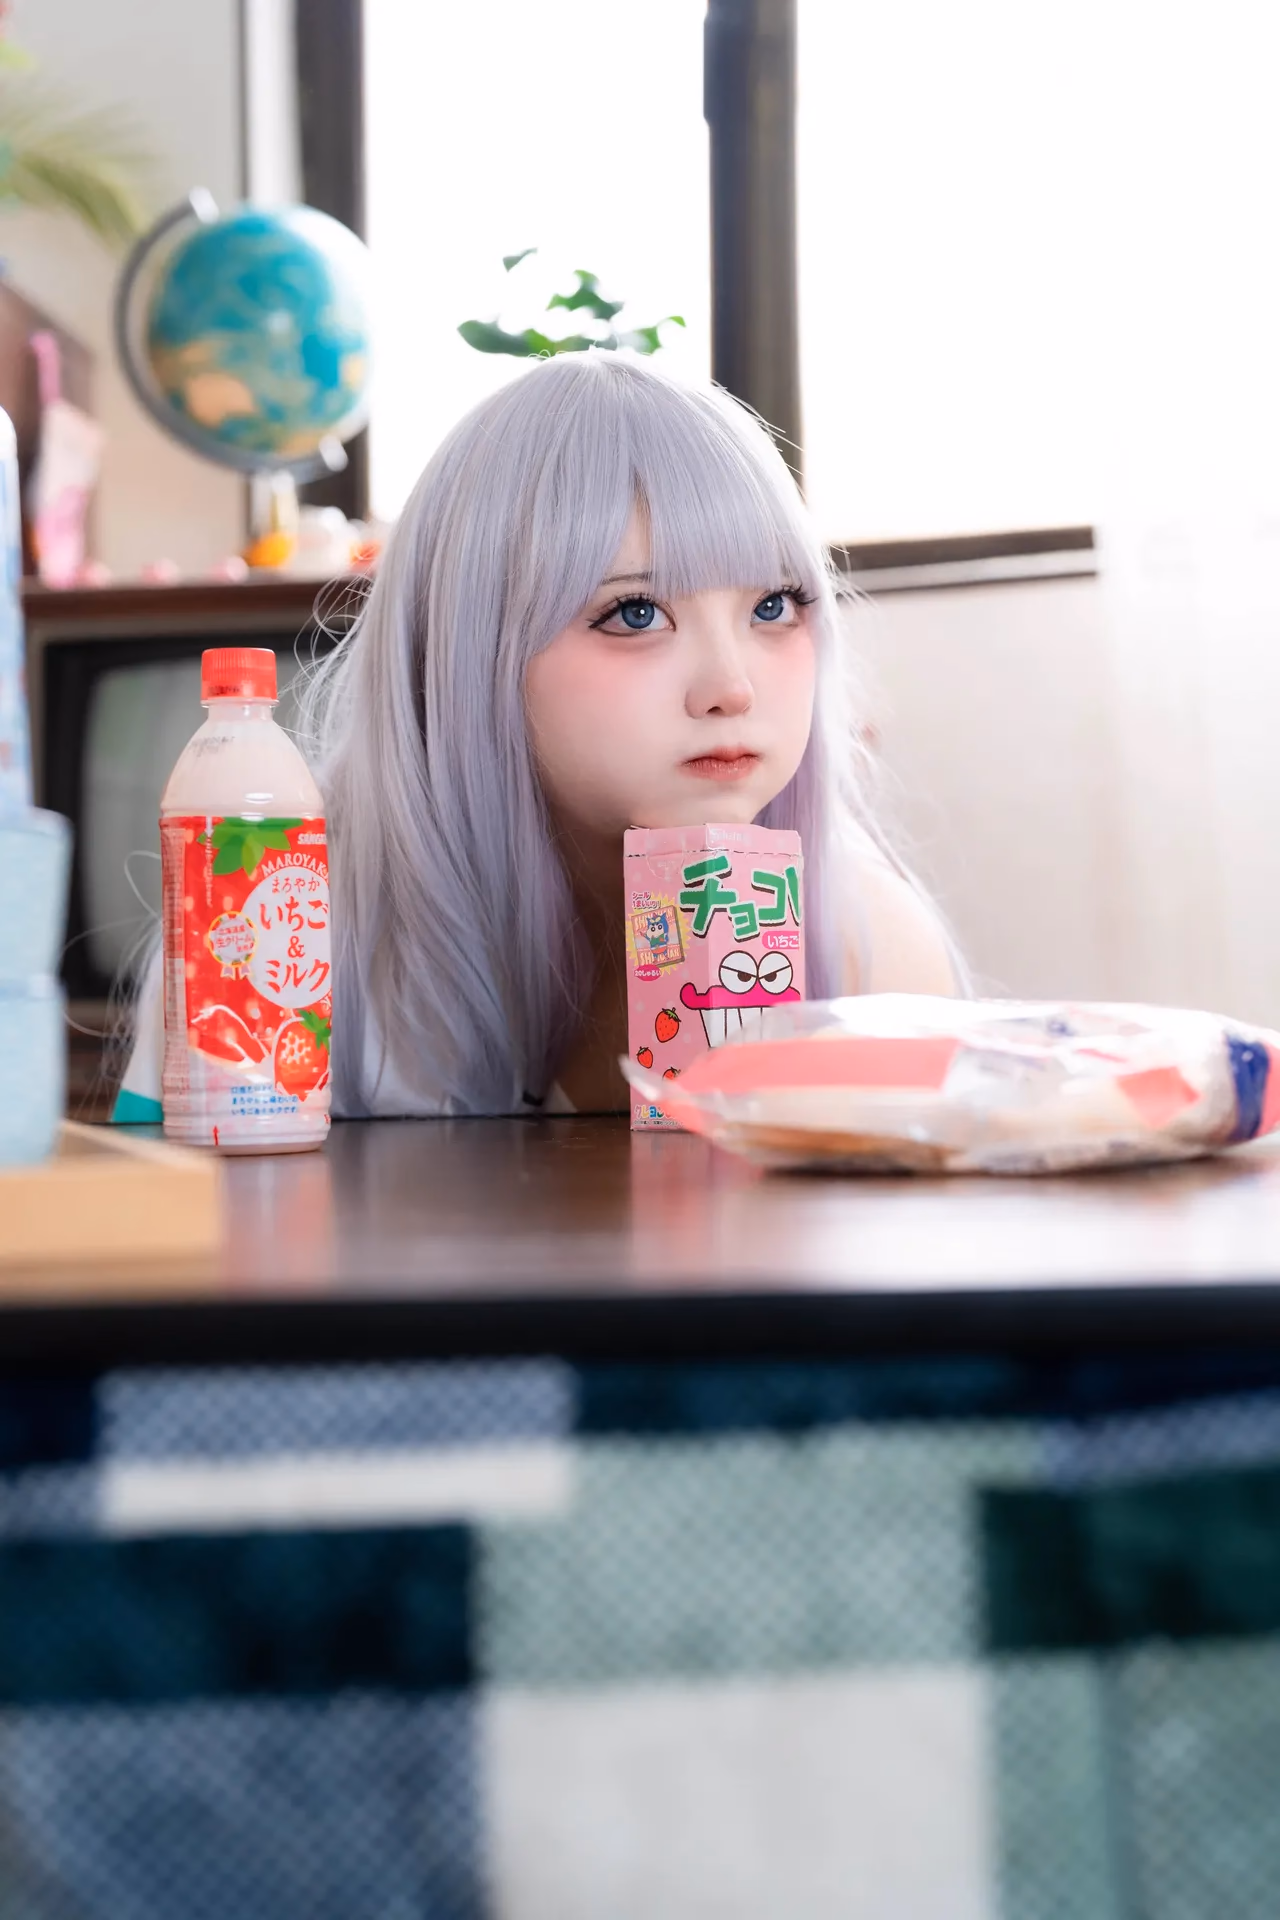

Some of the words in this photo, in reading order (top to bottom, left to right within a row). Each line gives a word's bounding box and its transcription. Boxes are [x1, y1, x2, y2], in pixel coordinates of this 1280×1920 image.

[271, 876, 320, 893] まろやか
[632, 891, 651, 900] シール
[259, 896, 329, 932] いちご
[287, 935, 306, 958] &
[265, 958, 330, 994] ミルク
